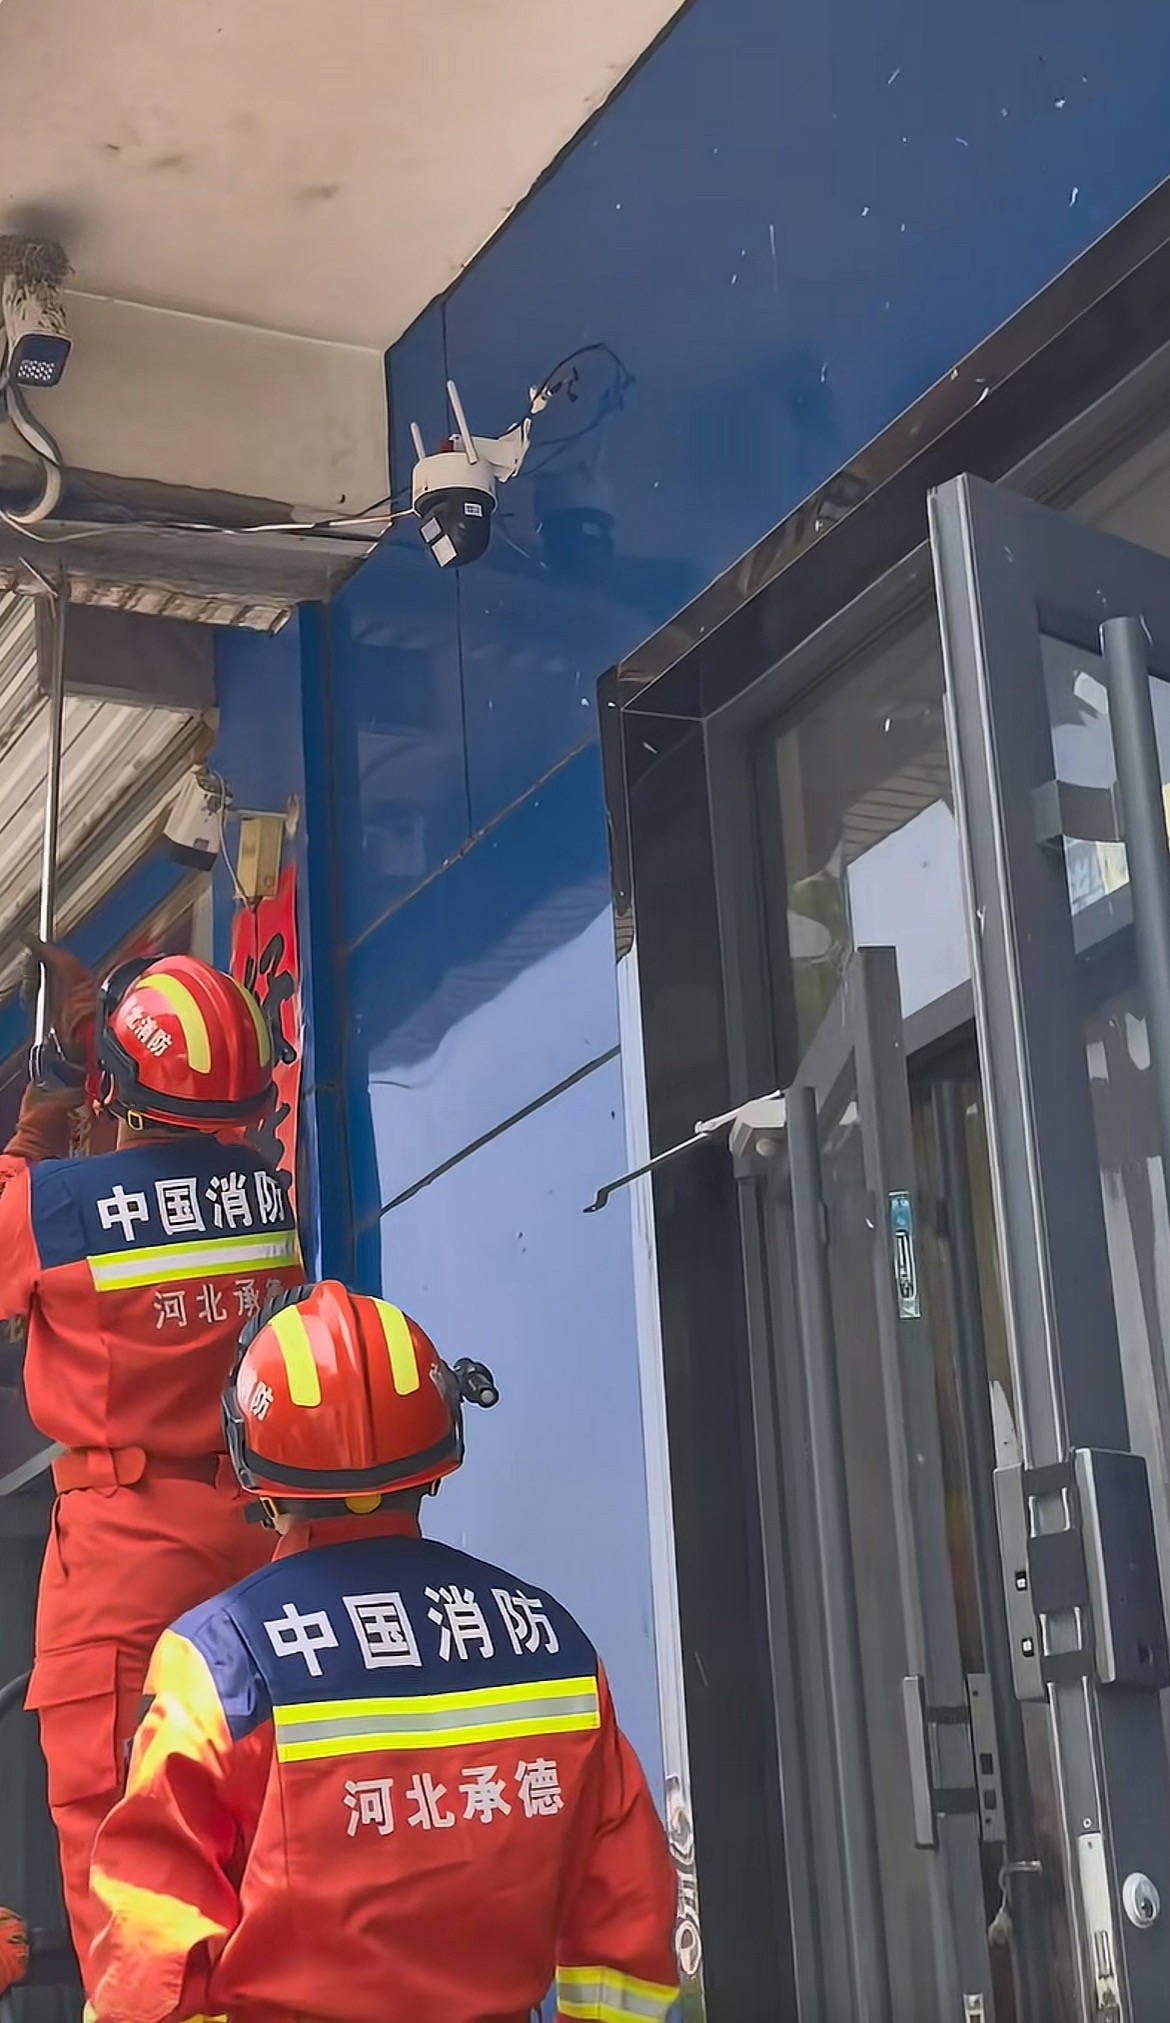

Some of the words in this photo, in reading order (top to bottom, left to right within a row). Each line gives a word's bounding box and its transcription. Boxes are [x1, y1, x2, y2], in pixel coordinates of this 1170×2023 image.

[97, 1171, 285, 1241] 中国消防
[263, 1585, 560, 1677] 中国消防
[344, 1758, 564, 1837] 河北承德
